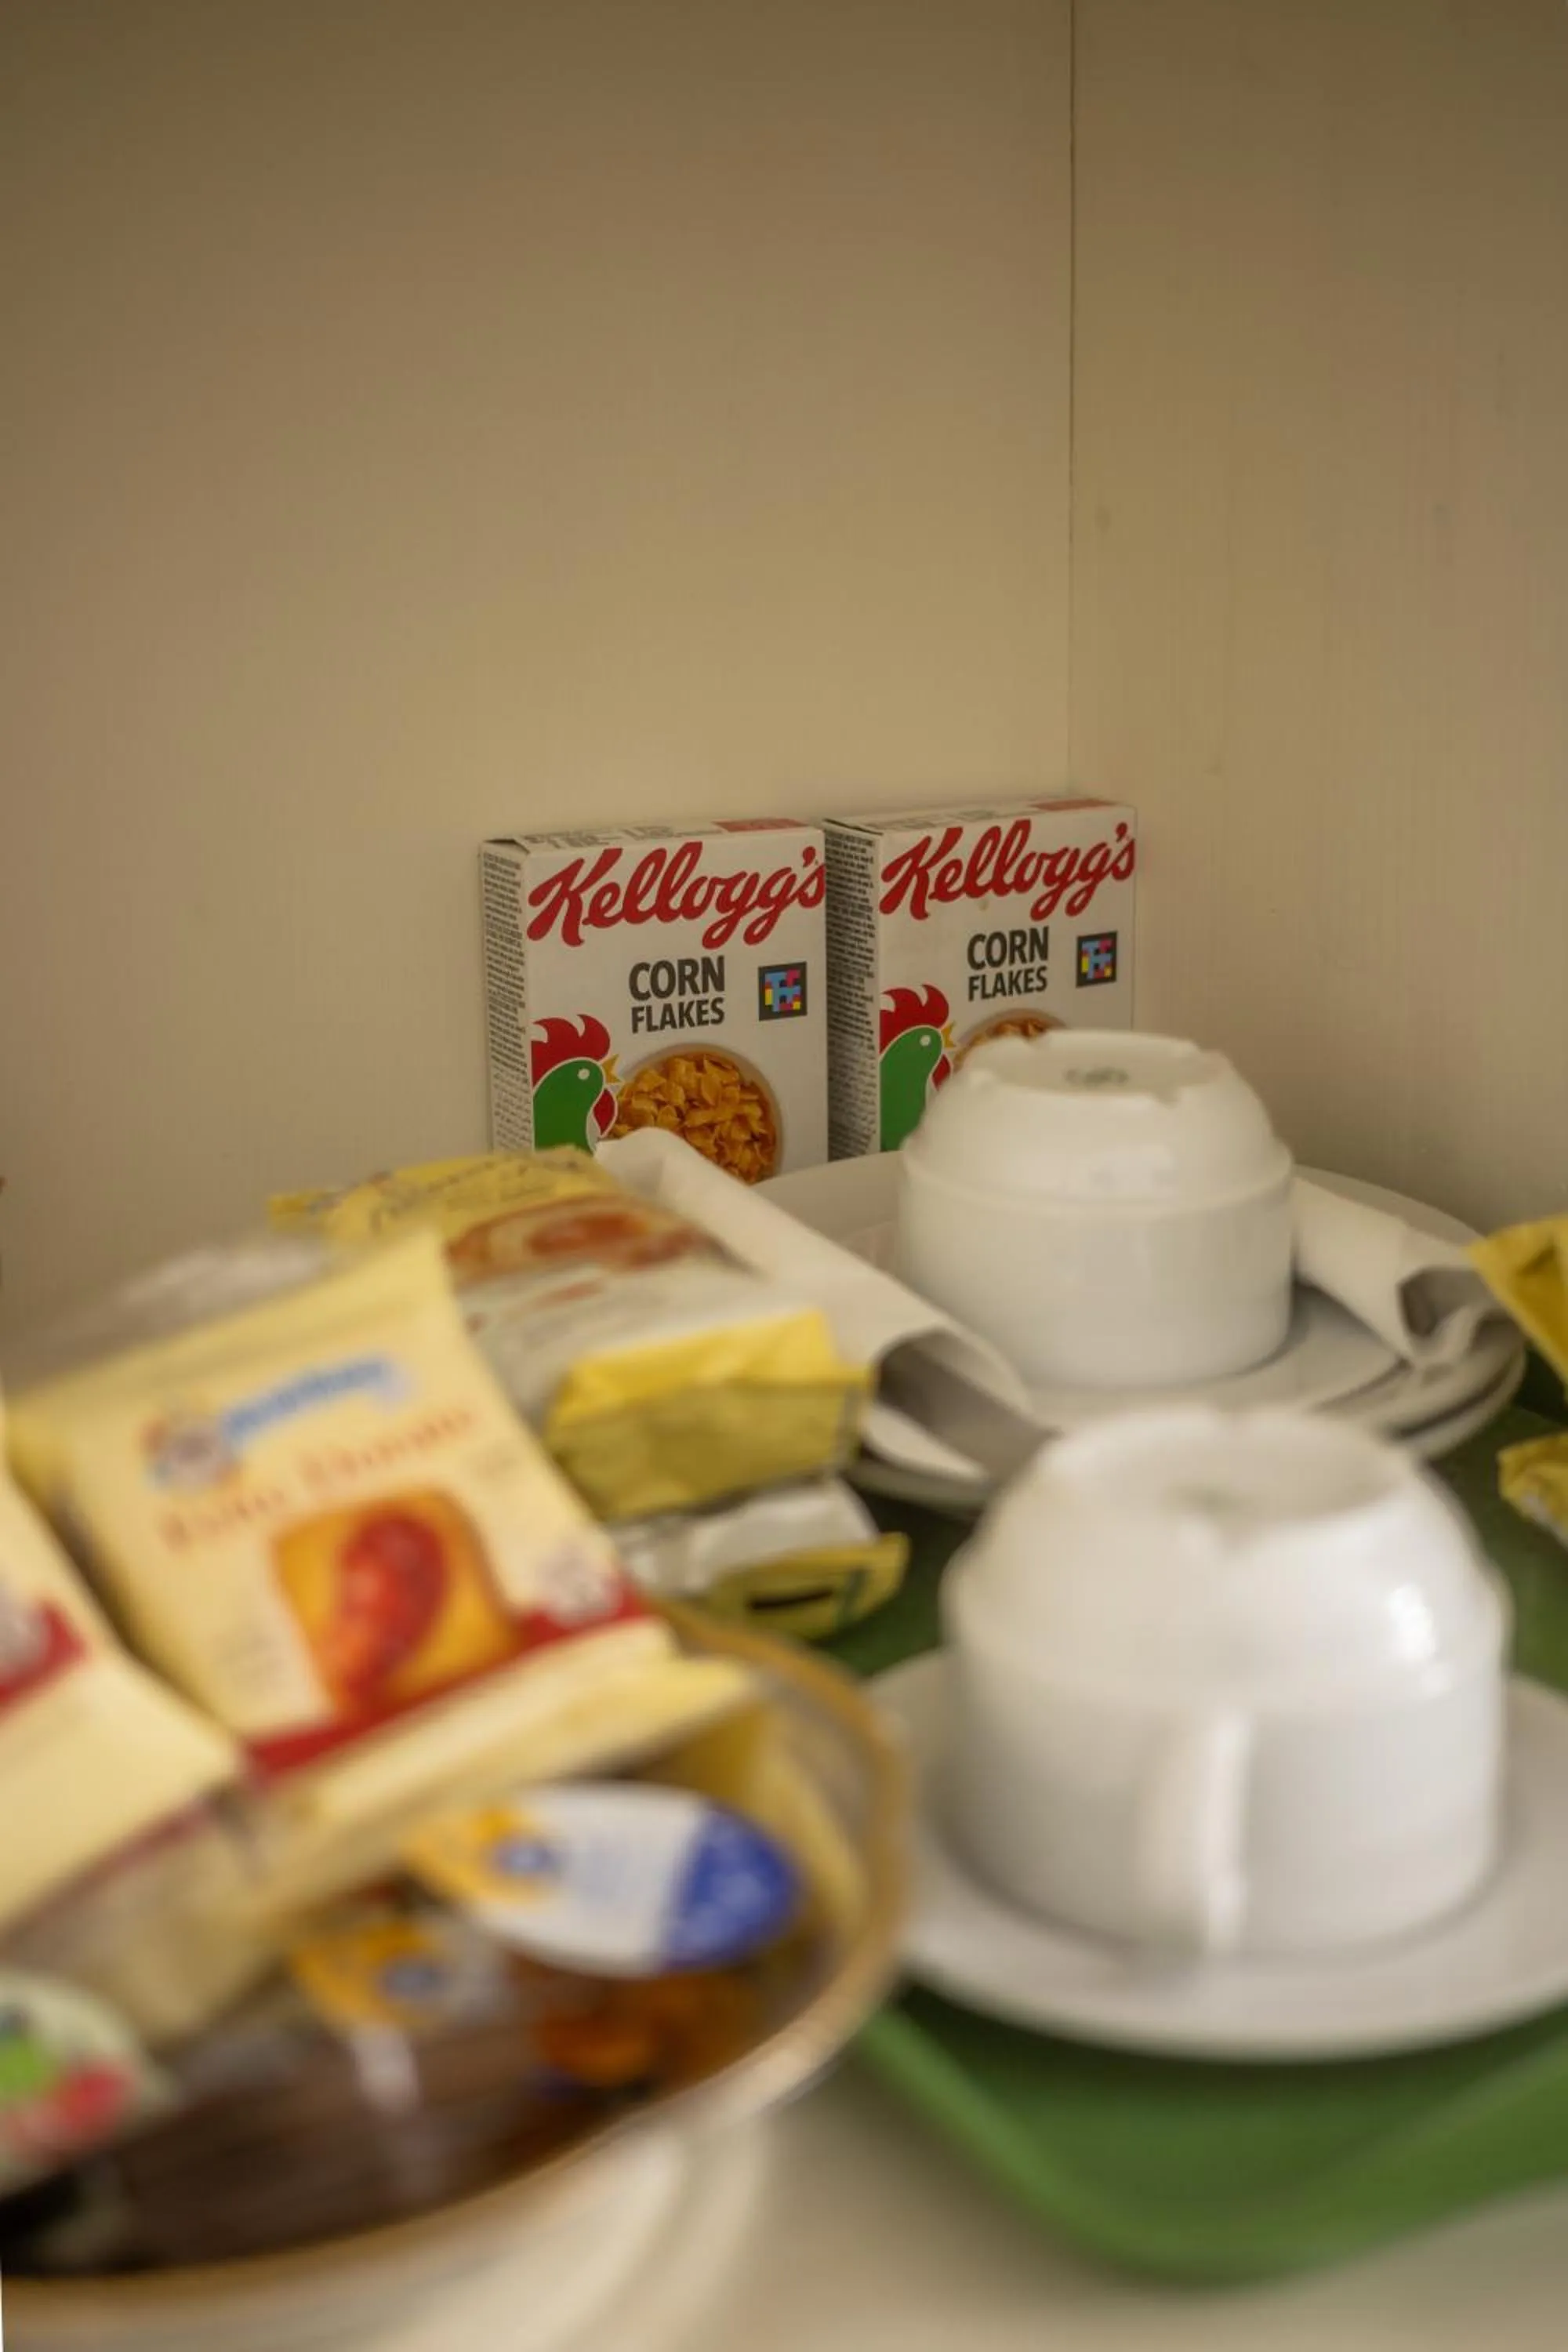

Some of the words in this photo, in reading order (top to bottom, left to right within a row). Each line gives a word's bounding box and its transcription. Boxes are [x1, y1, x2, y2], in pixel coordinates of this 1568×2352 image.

[879, 818, 1136, 921] Kellogg's
[526, 841, 826, 949] Kellogg's
[967, 926, 1050, 971] CORN
[629, 955, 725, 1002] CORN
[968, 966, 1047, 1001] FLAKES
[630, 996, 725, 1034] FLAKES
